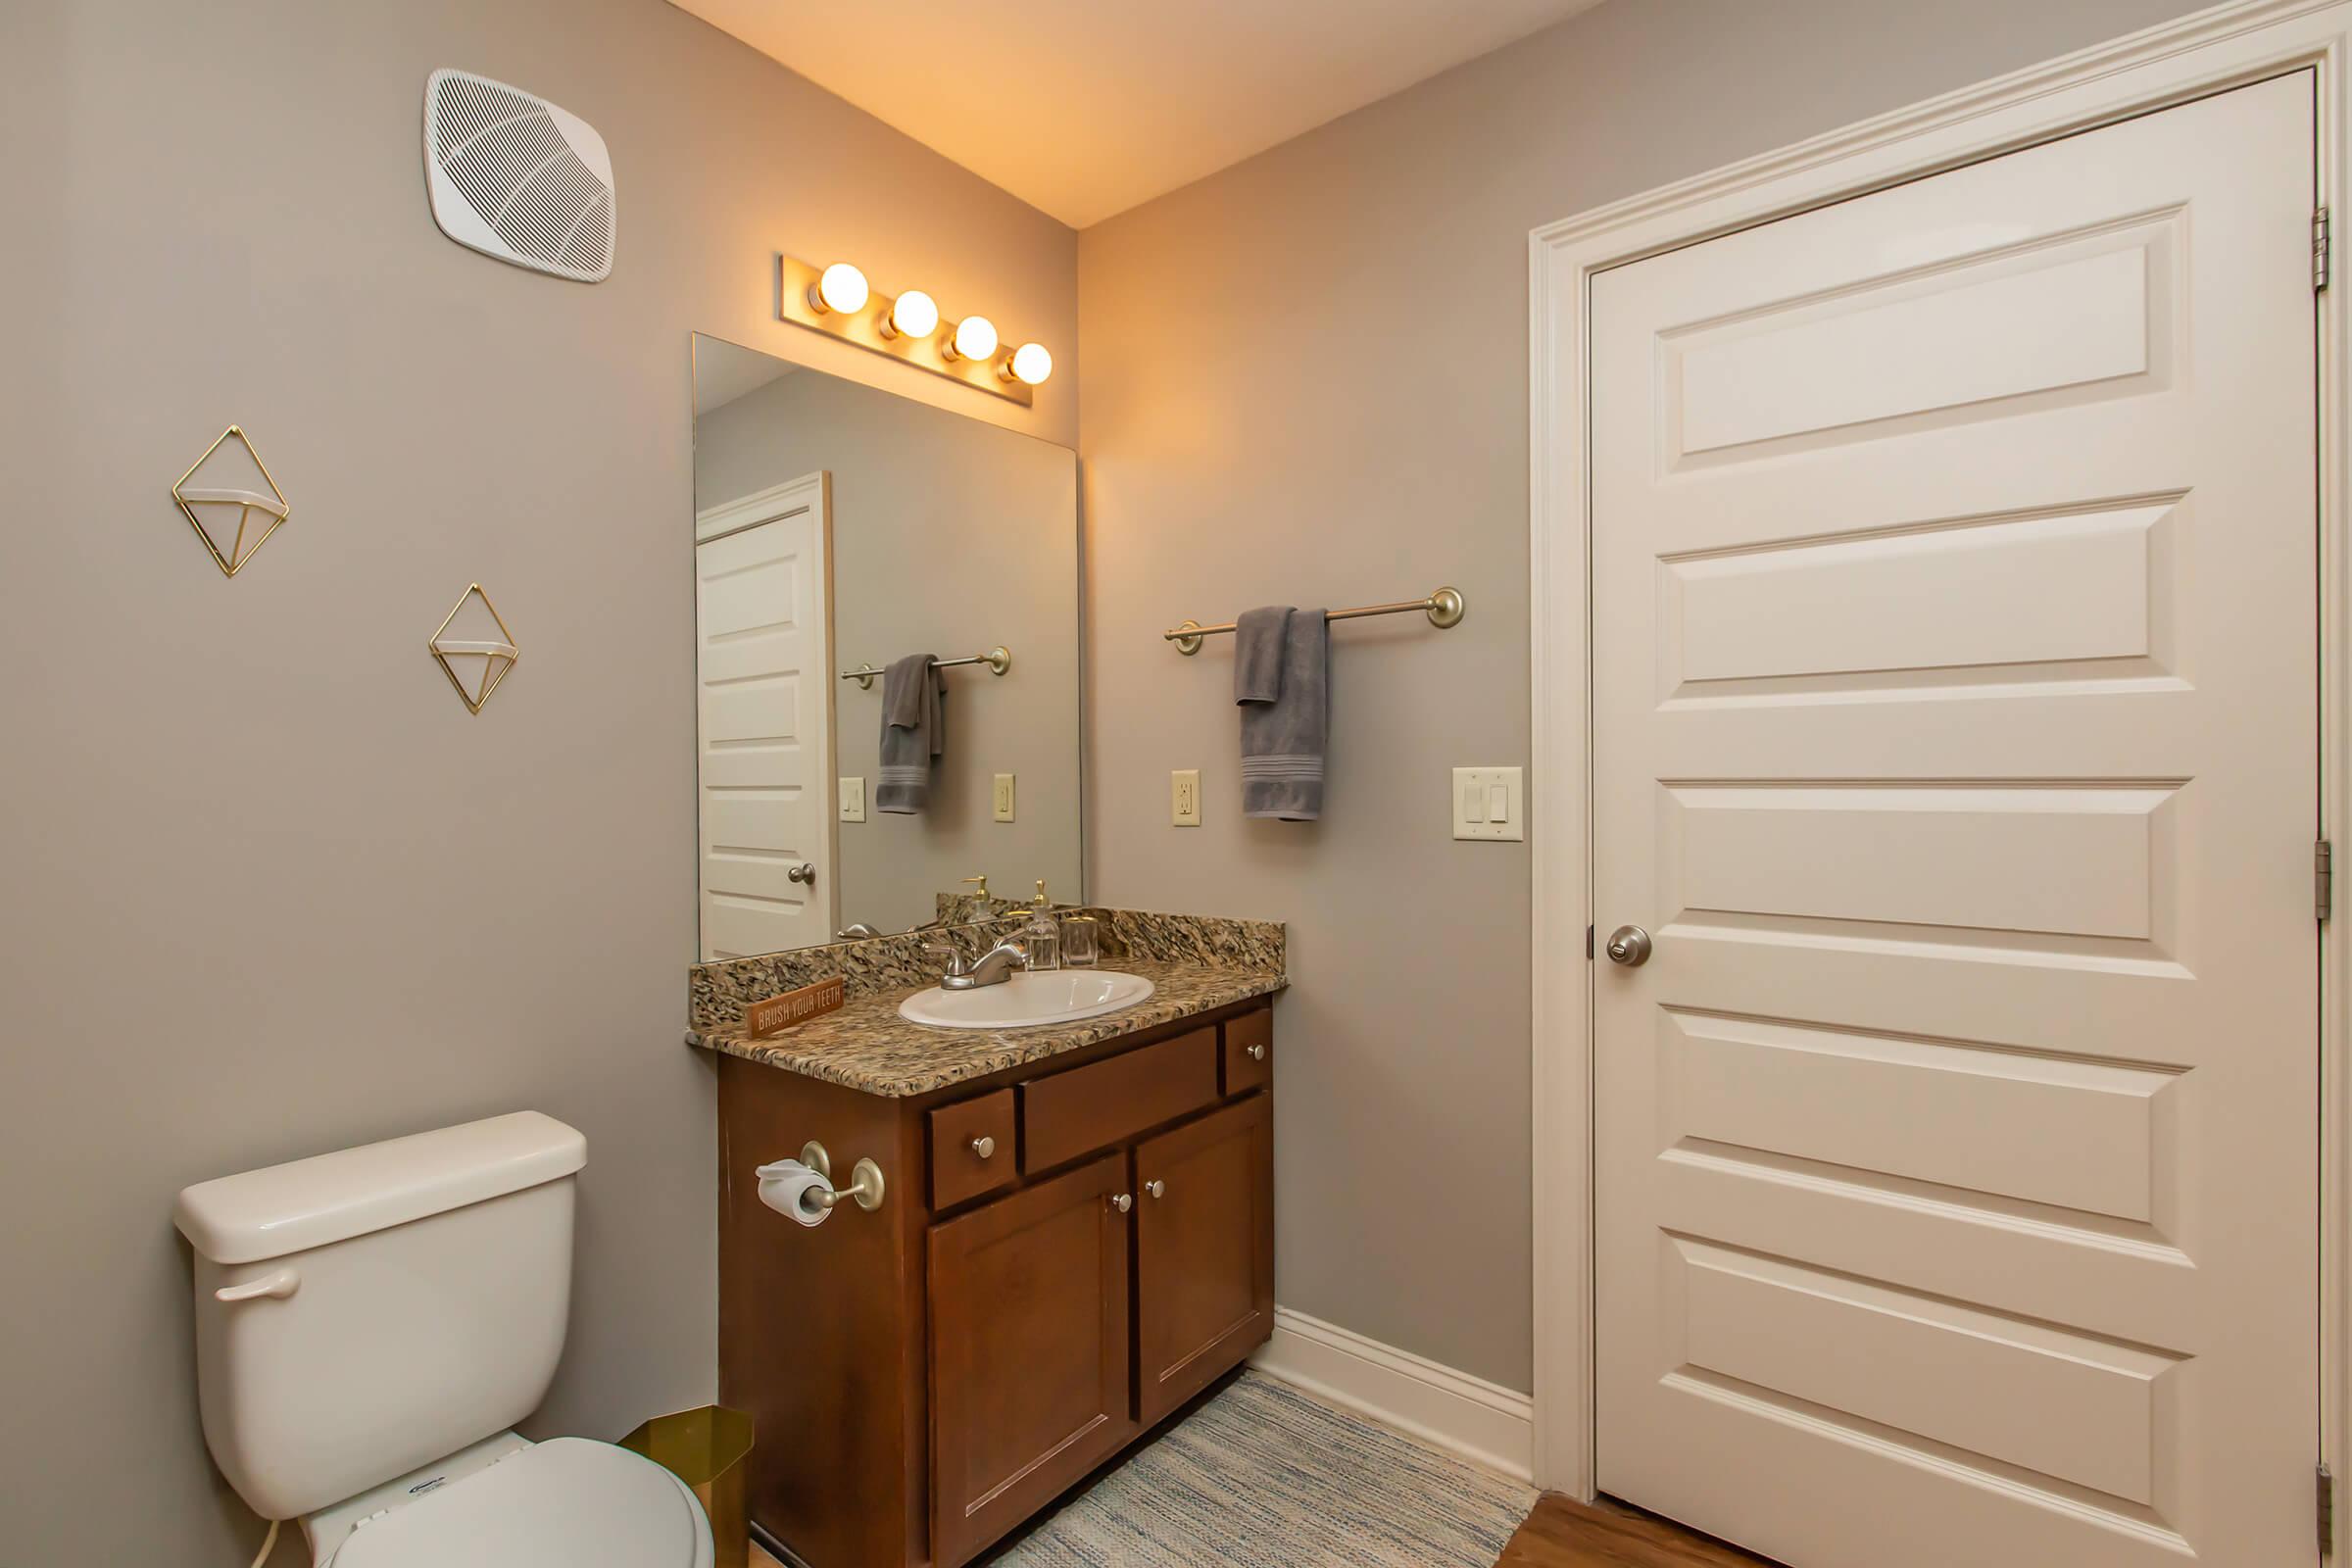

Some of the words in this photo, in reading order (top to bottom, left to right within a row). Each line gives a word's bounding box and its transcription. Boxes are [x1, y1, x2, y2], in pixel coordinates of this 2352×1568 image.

[758, 1004, 790, 1031] BRUSH
[792, 994, 814, 1017] YOUR
[816, 985, 841, 1009] TEETH
